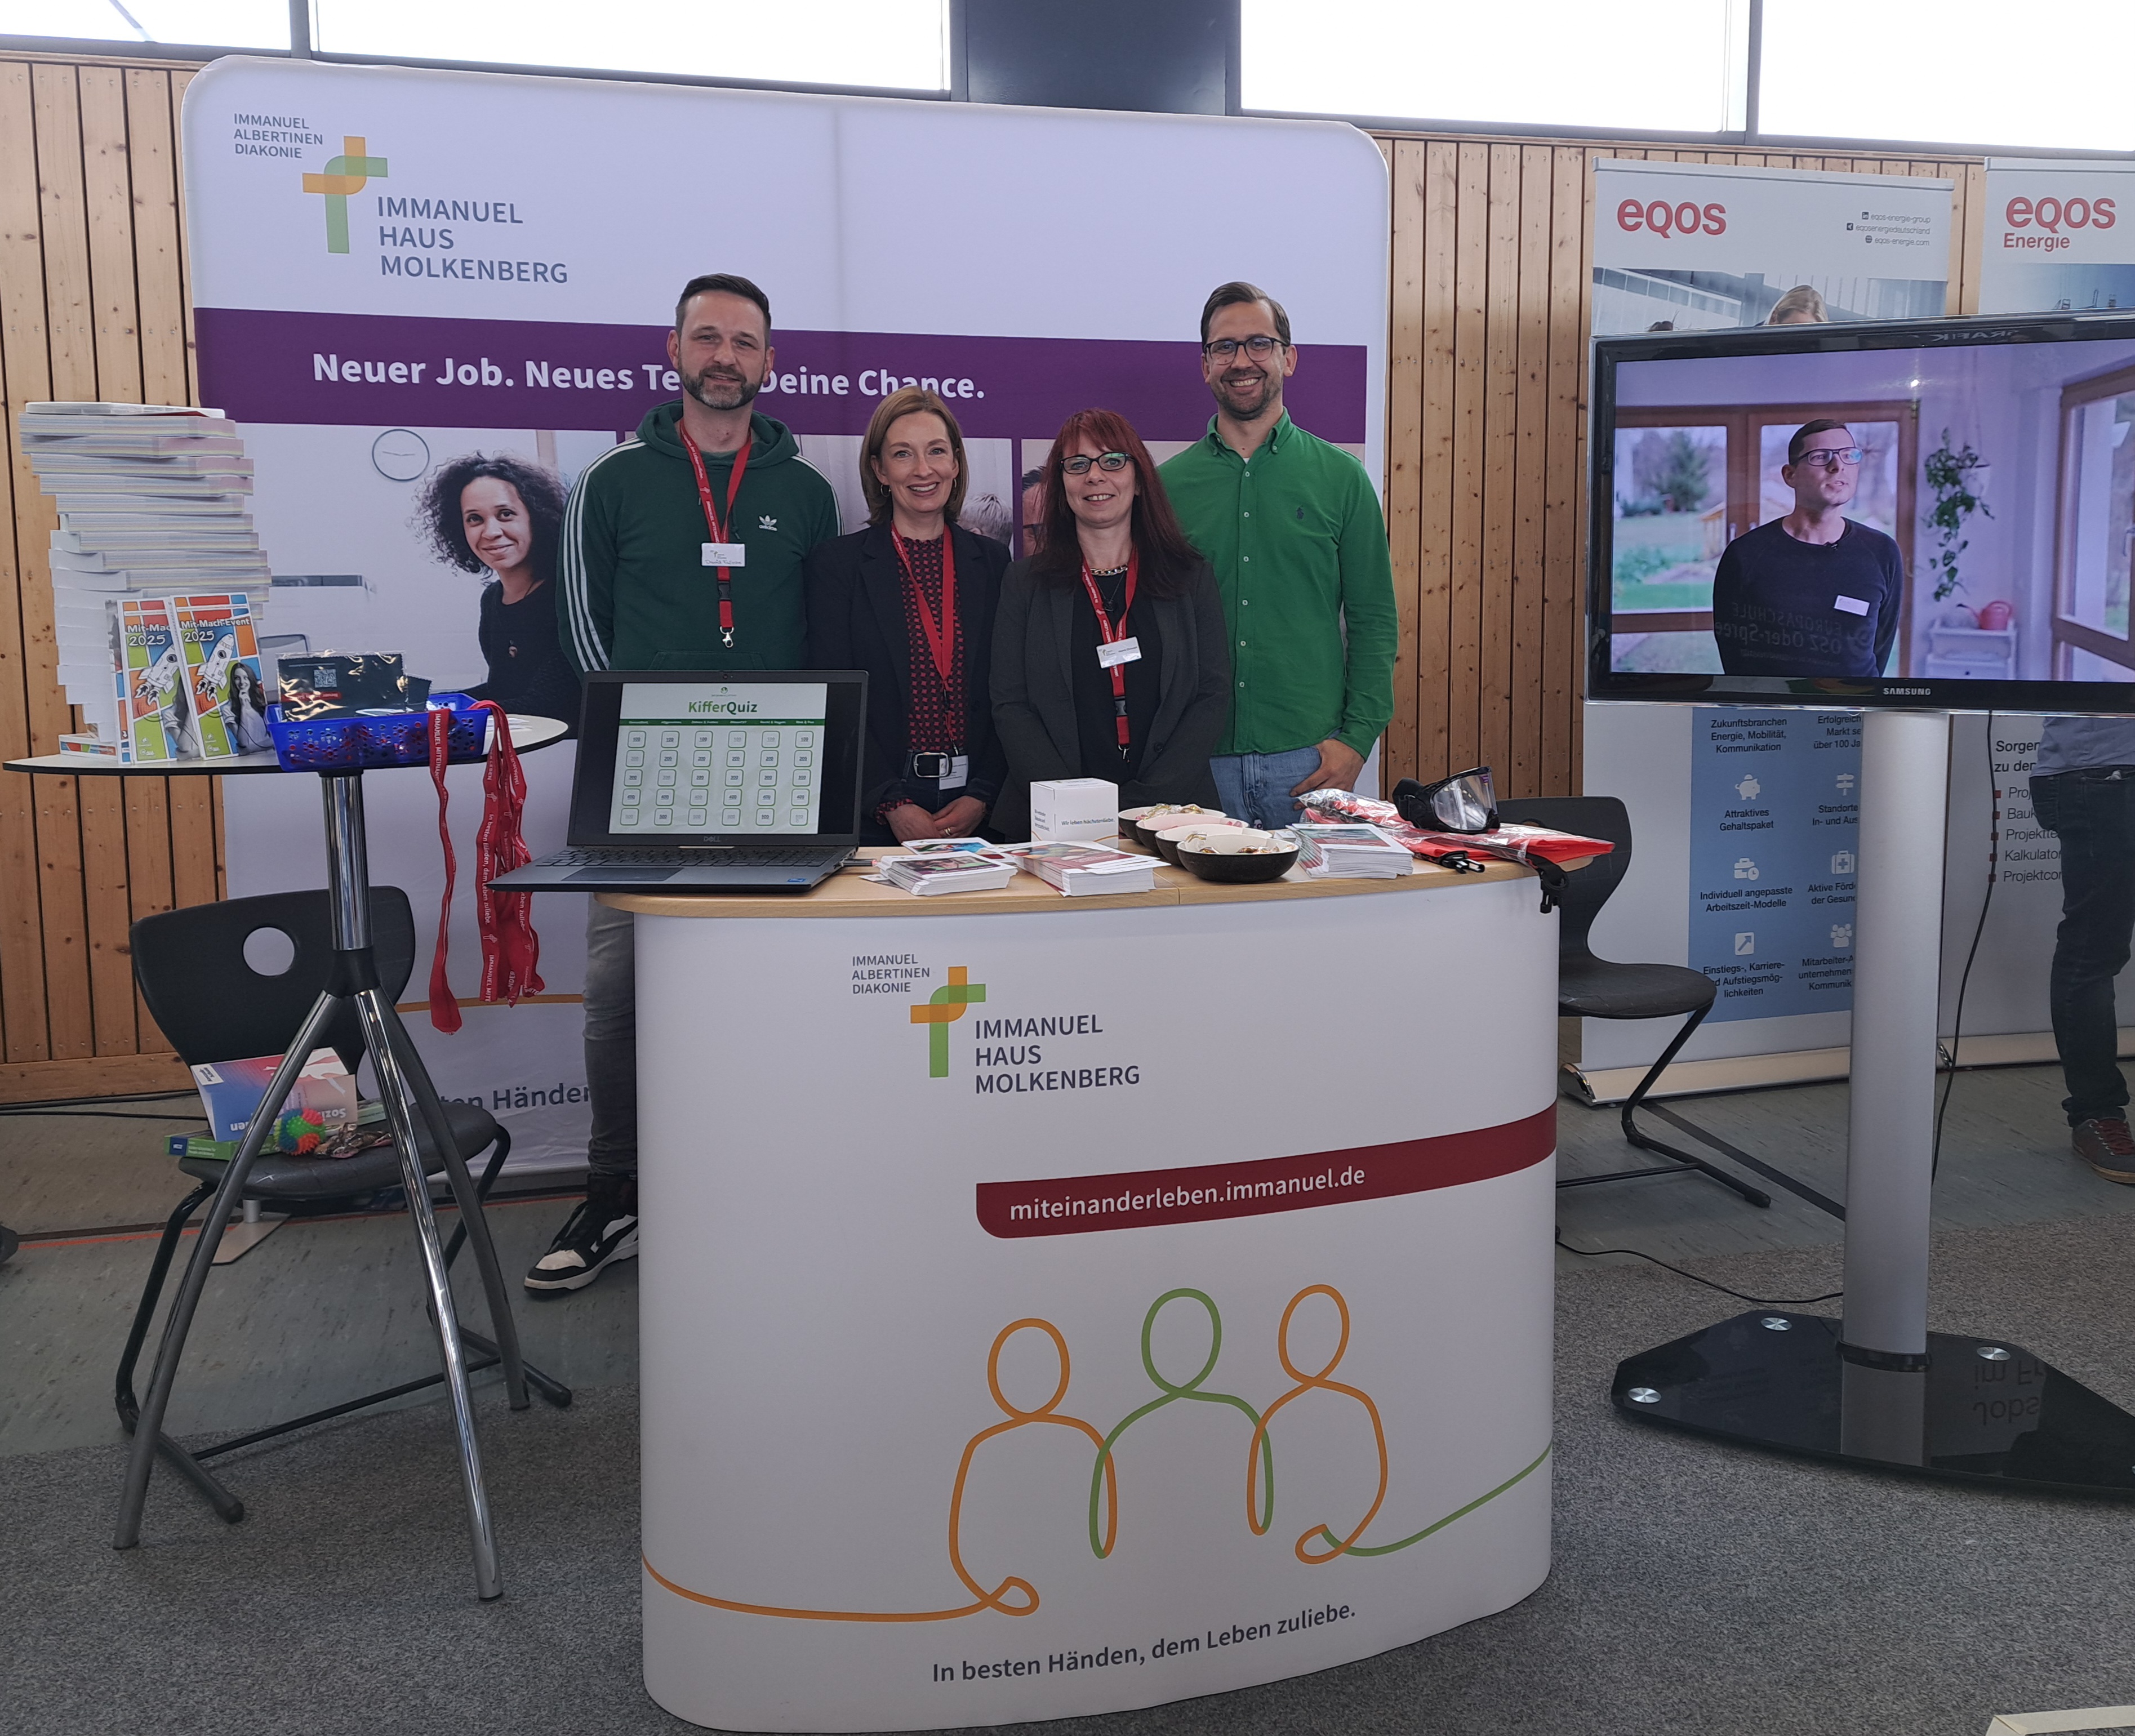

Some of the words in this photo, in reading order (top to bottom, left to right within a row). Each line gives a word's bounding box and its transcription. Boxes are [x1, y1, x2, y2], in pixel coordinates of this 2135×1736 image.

[234, 113, 309, 130] IMMANUEL
[234, 129, 323, 145] ALBERTINEN
[234, 144, 303, 159] DIAKONIE
[377, 196, 523, 224] IMMANUEL
[379, 226, 454, 250] HAUS
[2003, 232, 2070, 252] Energie
[381, 255, 568, 283] MOLKENBERG
[312, 353, 425, 384] Neuer
[435, 357, 515, 389] Job.
[526, 361, 633, 391] Neues
[642, 364, 679, 390] Te
[181, 618, 250, 629] Mit-Mach-Event
[128, 635, 166, 646] 2025
[184, 630, 215, 642] 2025
[1883, 687, 1931, 696] SAMSUNG
[688, 701, 758, 715] KifferQuiz
[1711, 718, 1787, 728] Zukunftsbranchen
[1817, 715, 1861, 725] Erfolgreich
[1711, 731, 1745, 742] Energie,
[1747, 729, 1787, 741] Mobilität,
[1826, 727, 1850, 736] Markt
[1716, 742, 1781, 754] Kommunikation
[1814, 740, 1832, 749] über
[1834, 739, 1849, 748] 100
[1851, 739, 1861, 747] Ja
[1994, 763, 2009, 772] zu
[2008, 787, 2031, 800] Proj
[1724, 808, 1769, 819] Attraktives
[1818, 803, 1858, 814] Standorte
[2007, 807, 2036, 820] Bauk
[1719, 820, 1774, 832] Gehaltspaket
[1812, 817, 1824, 826] In-
[1826, 816, 1842, 826] und
[1842, 815, 1858, 825] Aus
[2005, 849, 2061, 861] Kalkulator
[1700, 889, 1743, 901] Individuell
[1745, 886, 1793, 900] angepasste
[1808, 884, 1833, 893] Aktive
[1705, 899, 1787, 913] Arbeitszeit-Modelle
[852, 954, 918, 967] IMMANUEL
[1802, 955, 1853, 967] Mitarbeiter-A
[852, 967, 931, 981] ALBERTINEN
[1703, 963, 1747, 976] Einstiegs-,
[1749, 962, 1785, 972] Karriere-
[1798, 968, 1852, 980] unternehmen
[1723, 974, 1783, 986] Aufstiegsmög-
[1809, 980, 1852, 991] Kommunik
[852, 982, 911, 994] DIAKONIE
[1724, 987, 1764, 998] lichkeiten
[975, 1014, 1103, 1039] IMMANUEL
[975, 1044, 1042, 1067] HAUS
[975, 1065, 1140, 1094] MOLKENBERG
[321, 1108, 346, 1118] Sozi
[1010, 1165, 1366, 1221] miteinanderleben.immanuel.de
[932, 1663, 954, 1682] In
[962, 1657, 1040, 1681] besten
[1048, 1646, 1145, 1674] Händen,
[1151, 1636, 1200, 1659] dem
[1206, 1622, 1271, 1650] Leben
[1276, 1603, 1355, 1636] zuliebe.
